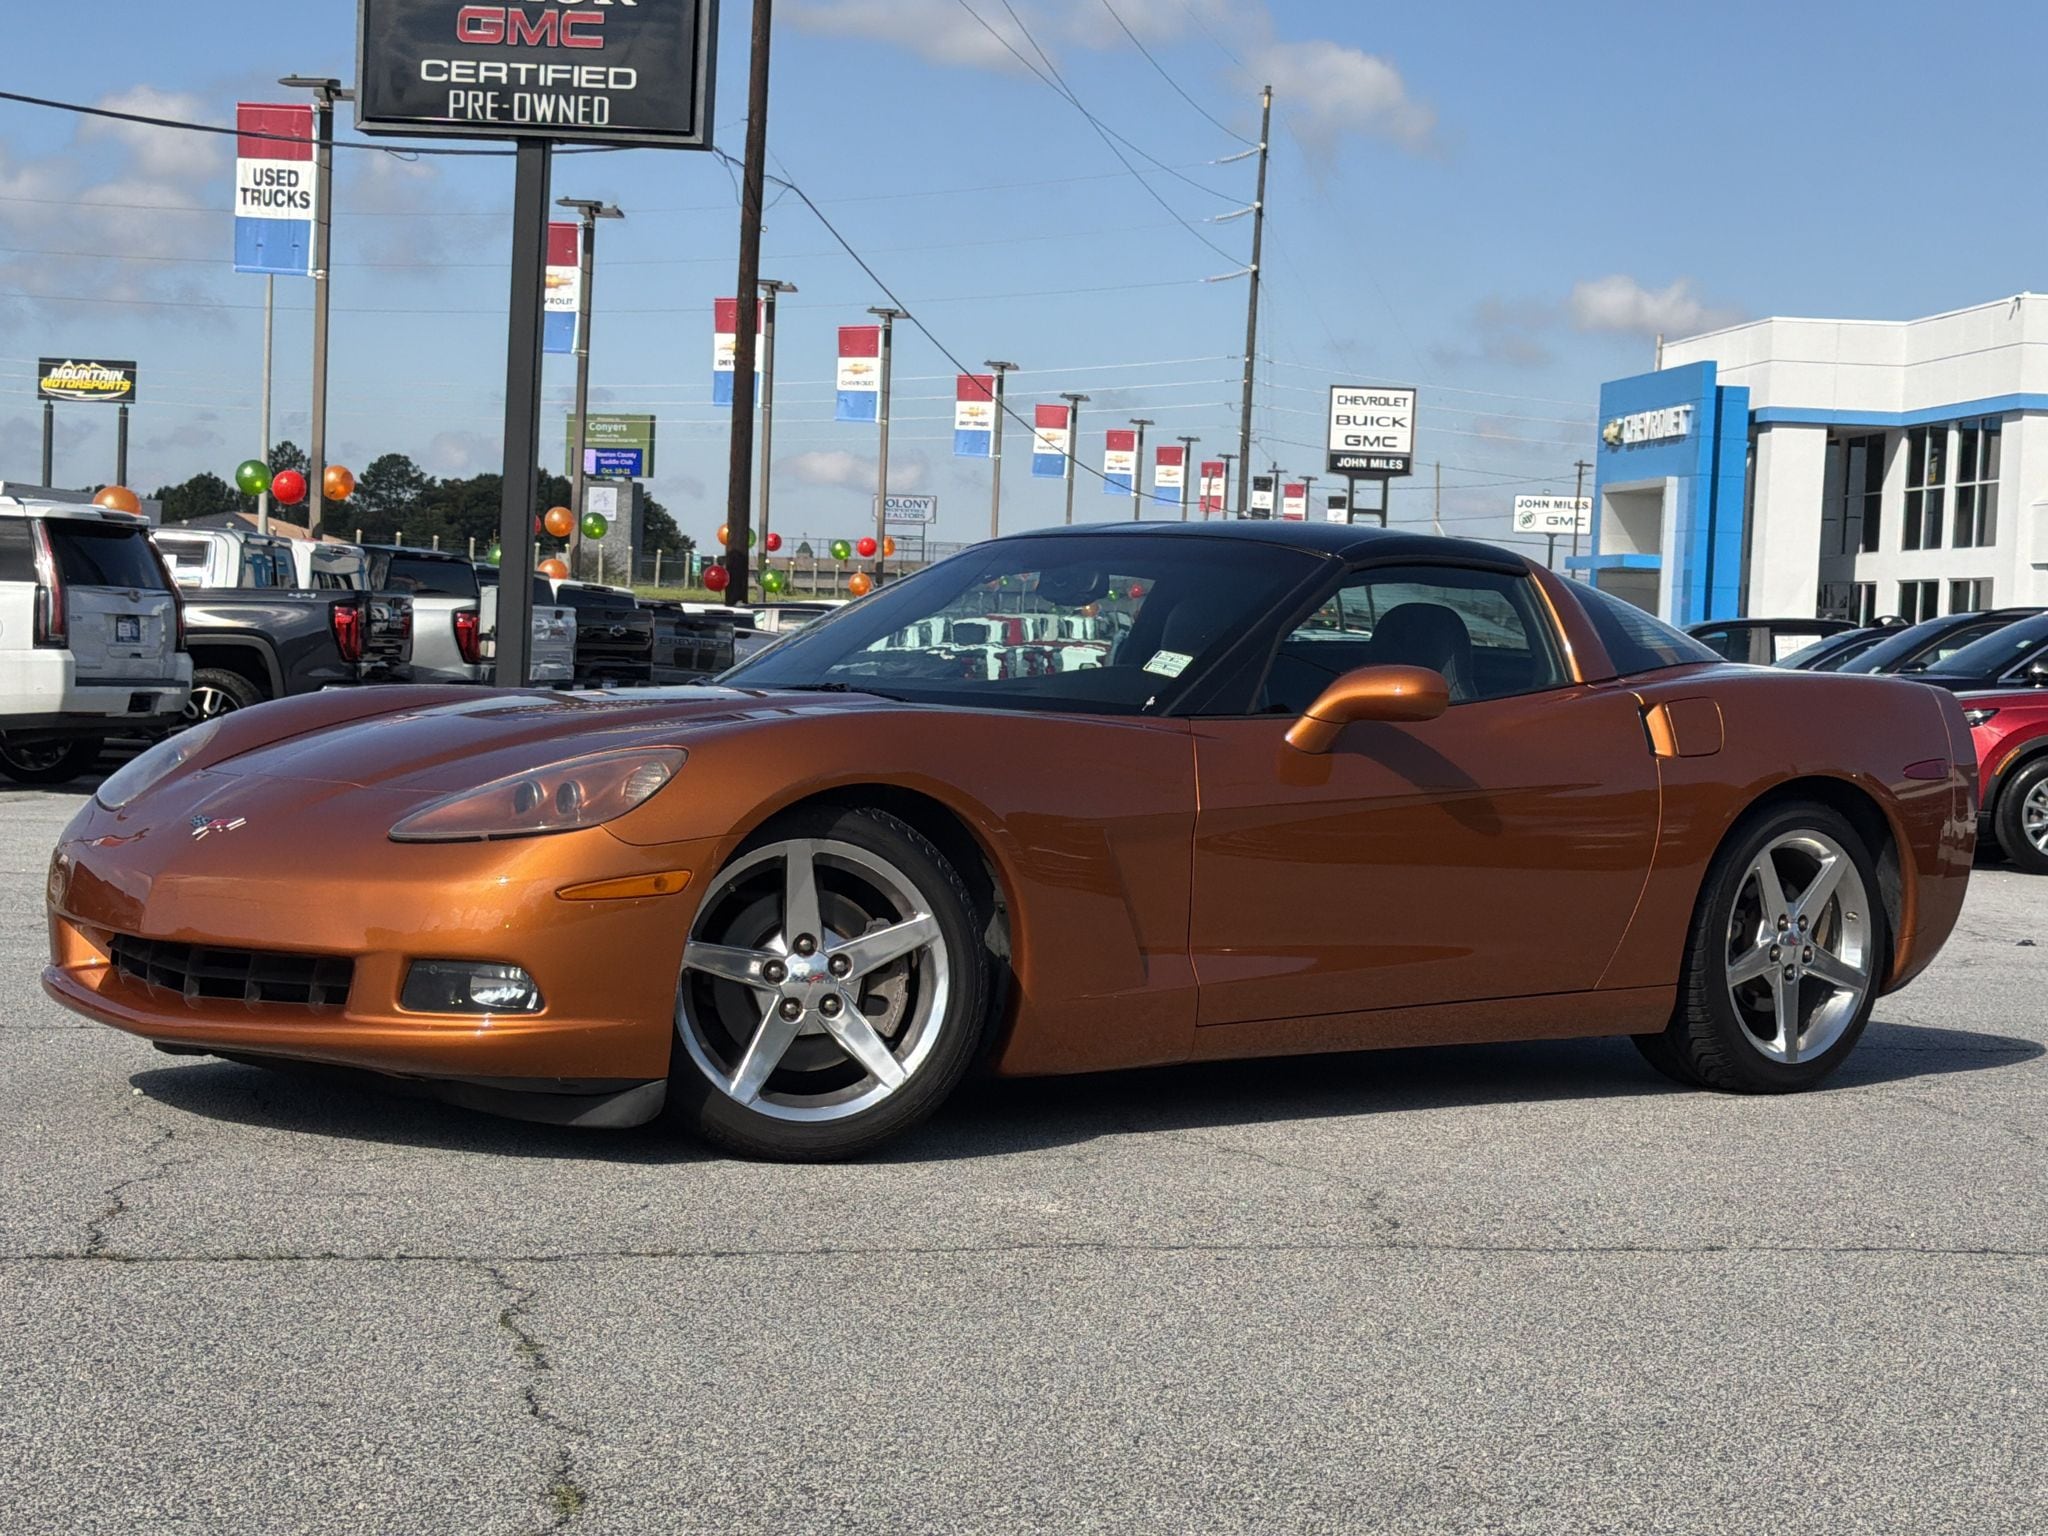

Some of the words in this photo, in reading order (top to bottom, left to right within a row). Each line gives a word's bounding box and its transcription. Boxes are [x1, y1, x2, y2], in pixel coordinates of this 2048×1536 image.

[456, 5, 604, 49] GMC
[420, 59, 637, 89] CERTIFIED
[448, 89, 610, 125] PRE-OWNED
[253, 167, 299, 187] USED
[240, 187, 311, 209] TRUCKS
[50, 367, 125, 381] MOUNTAIN
[42, 377, 132, 391] MOTORSPORTS
[1337, 395, 1409, 407] CHEVROLET
[588, 422, 628, 433] Conyers
[1335, 414, 1408, 428] BUICK
[1623, 404, 1696, 444] CHEVROLET
[1344, 434, 1398, 448] GMC
[1337, 457, 1367, 468] JOHN
[1370, 458, 1403, 470] MILES
[885, 498, 930, 509] OLONY
[1517, 499, 1550, 508] JOHN
[1546, 516, 1586, 526] GMC
